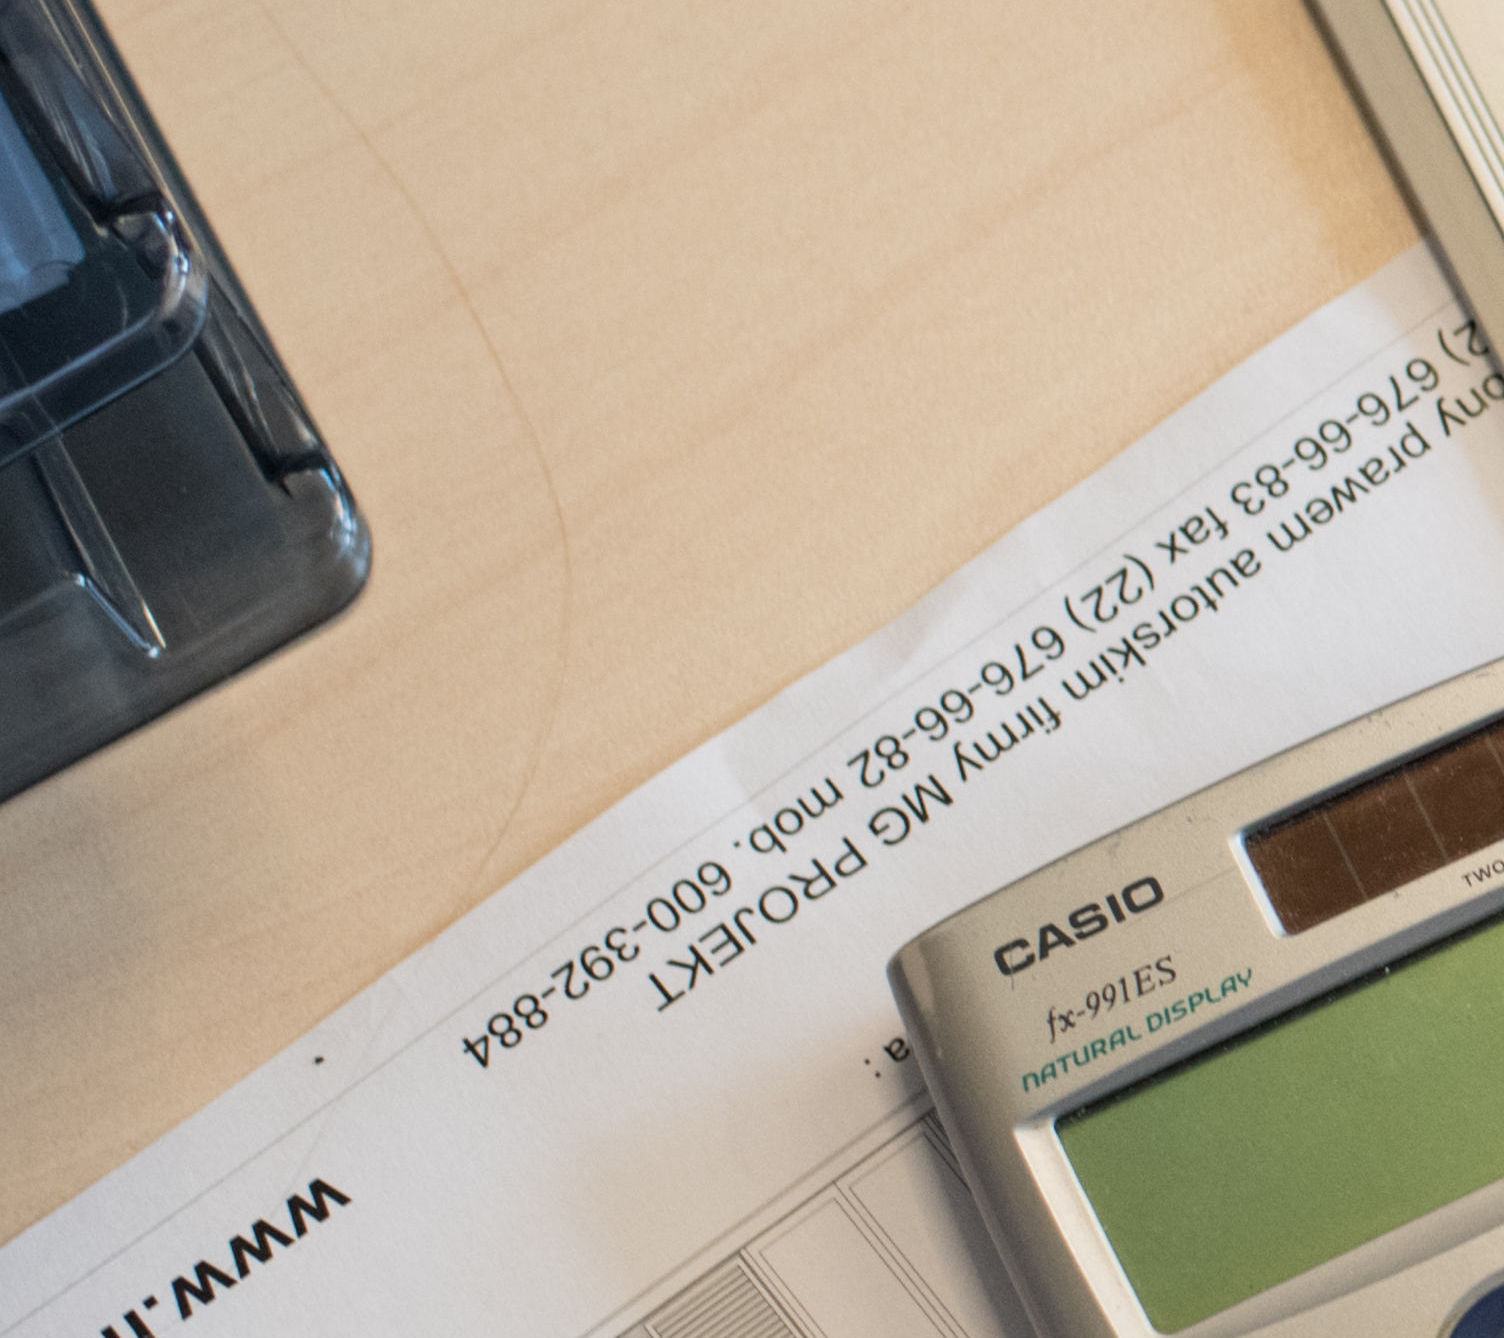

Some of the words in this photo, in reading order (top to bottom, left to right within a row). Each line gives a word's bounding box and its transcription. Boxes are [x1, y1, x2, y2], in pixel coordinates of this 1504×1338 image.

[1230, 357, 1440, 517] 676-66-83
[1266, 420, 1432, 554] prawem
[1156, 506, 1230, 565] fax
[1060, 547, 1263, 704] autorskim
[1064, 553, 1156, 632] (22)
[847, 626, 1066, 788] 676-66-82
[952, 695, 1064, 784] firmy
[731, 776, 843, 854] mob.
[867, 772, 954, 846] MG
[461, 860, 732, 1069] 600-392-884
[647, 836, 869, 1012] PROJEKT
[994, 876, 1165, 976] CASIO
[1021, 1024, 1142, 1093] NATURAL
[1145, 967, 1253, 1033] DISPLAY
[1046, 955, 1178, 1044] fx-991ES
